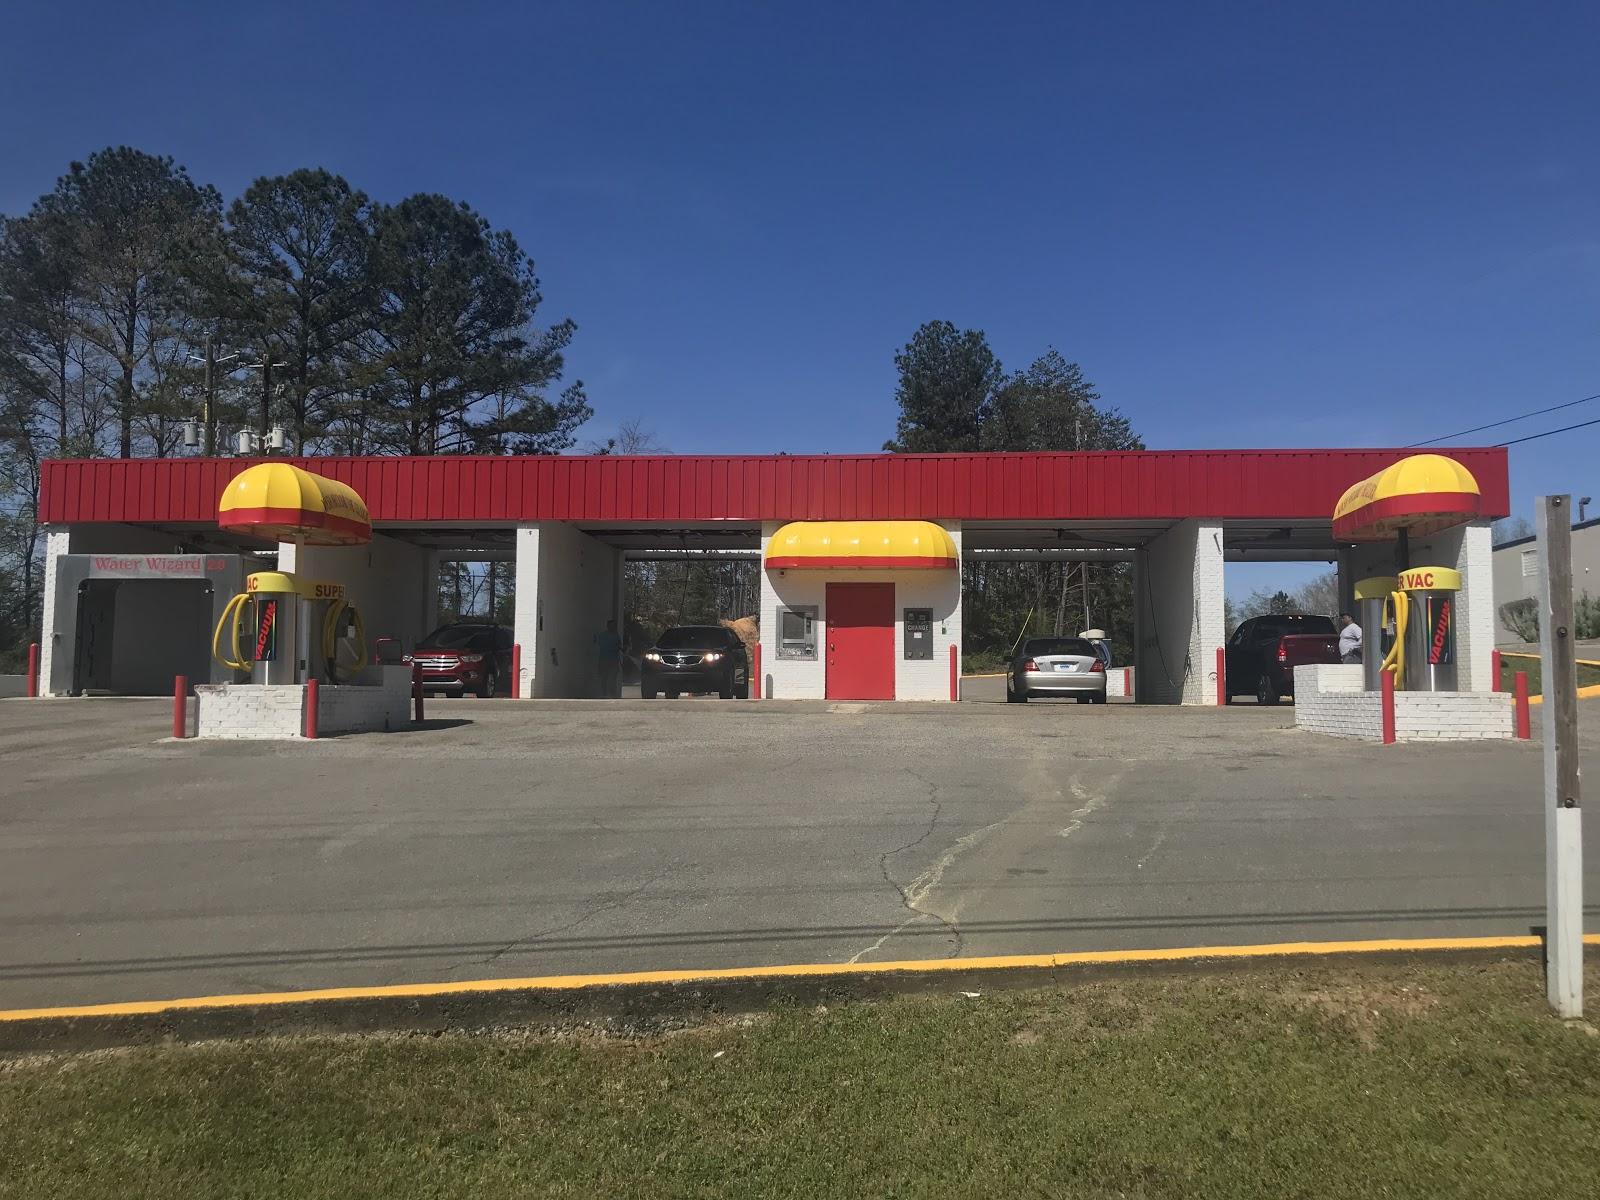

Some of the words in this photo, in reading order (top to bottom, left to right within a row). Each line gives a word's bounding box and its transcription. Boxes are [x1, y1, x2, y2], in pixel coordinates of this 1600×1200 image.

[95, 556, 141, 570] Water
[144, 556, 201, 571] Wizard
[1406, 572, 1434, 588] VAC
[255, 601, 278, 660] VACUUM
[1430, 601, 1450, 664] VACUUM
